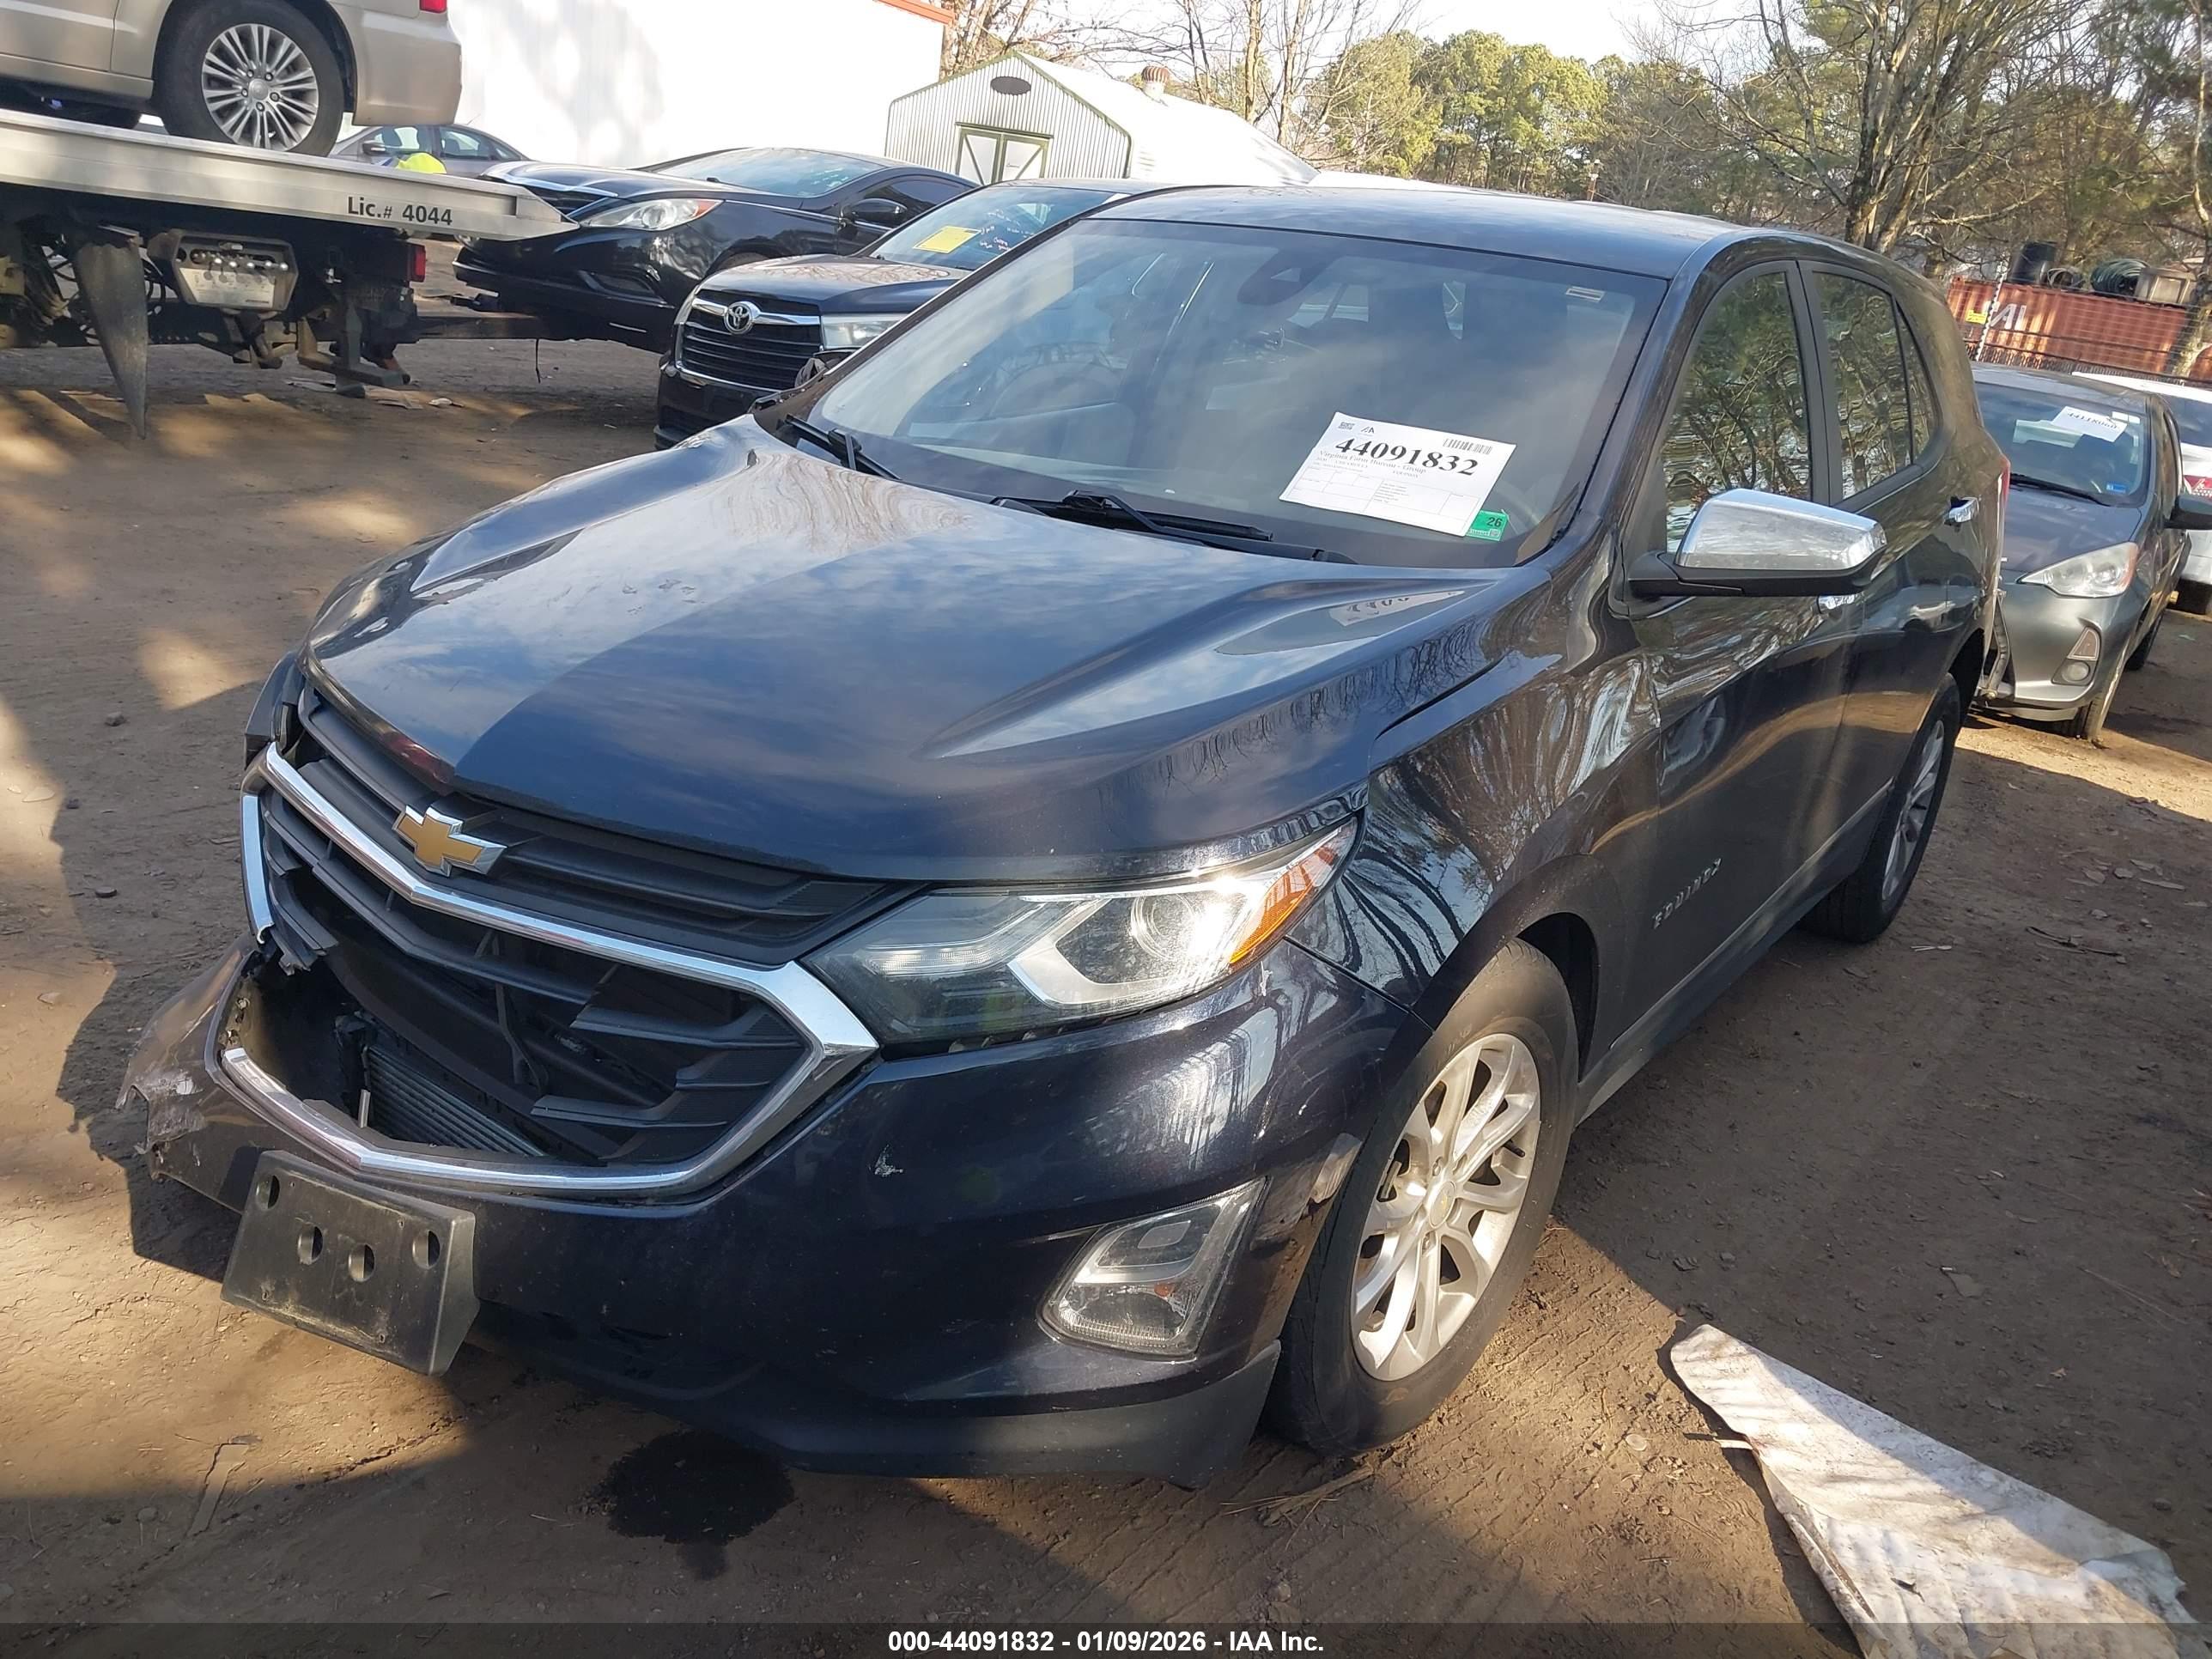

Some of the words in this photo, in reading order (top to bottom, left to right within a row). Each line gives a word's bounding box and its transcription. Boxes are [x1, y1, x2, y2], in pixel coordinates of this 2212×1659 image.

[402, 204, 453, 225] 4044
[1335, 437, 1479, 476] 44091832
[1486, 517, 1503, 527] 26
[1652, 859, 1722, 929] EQUINOX
